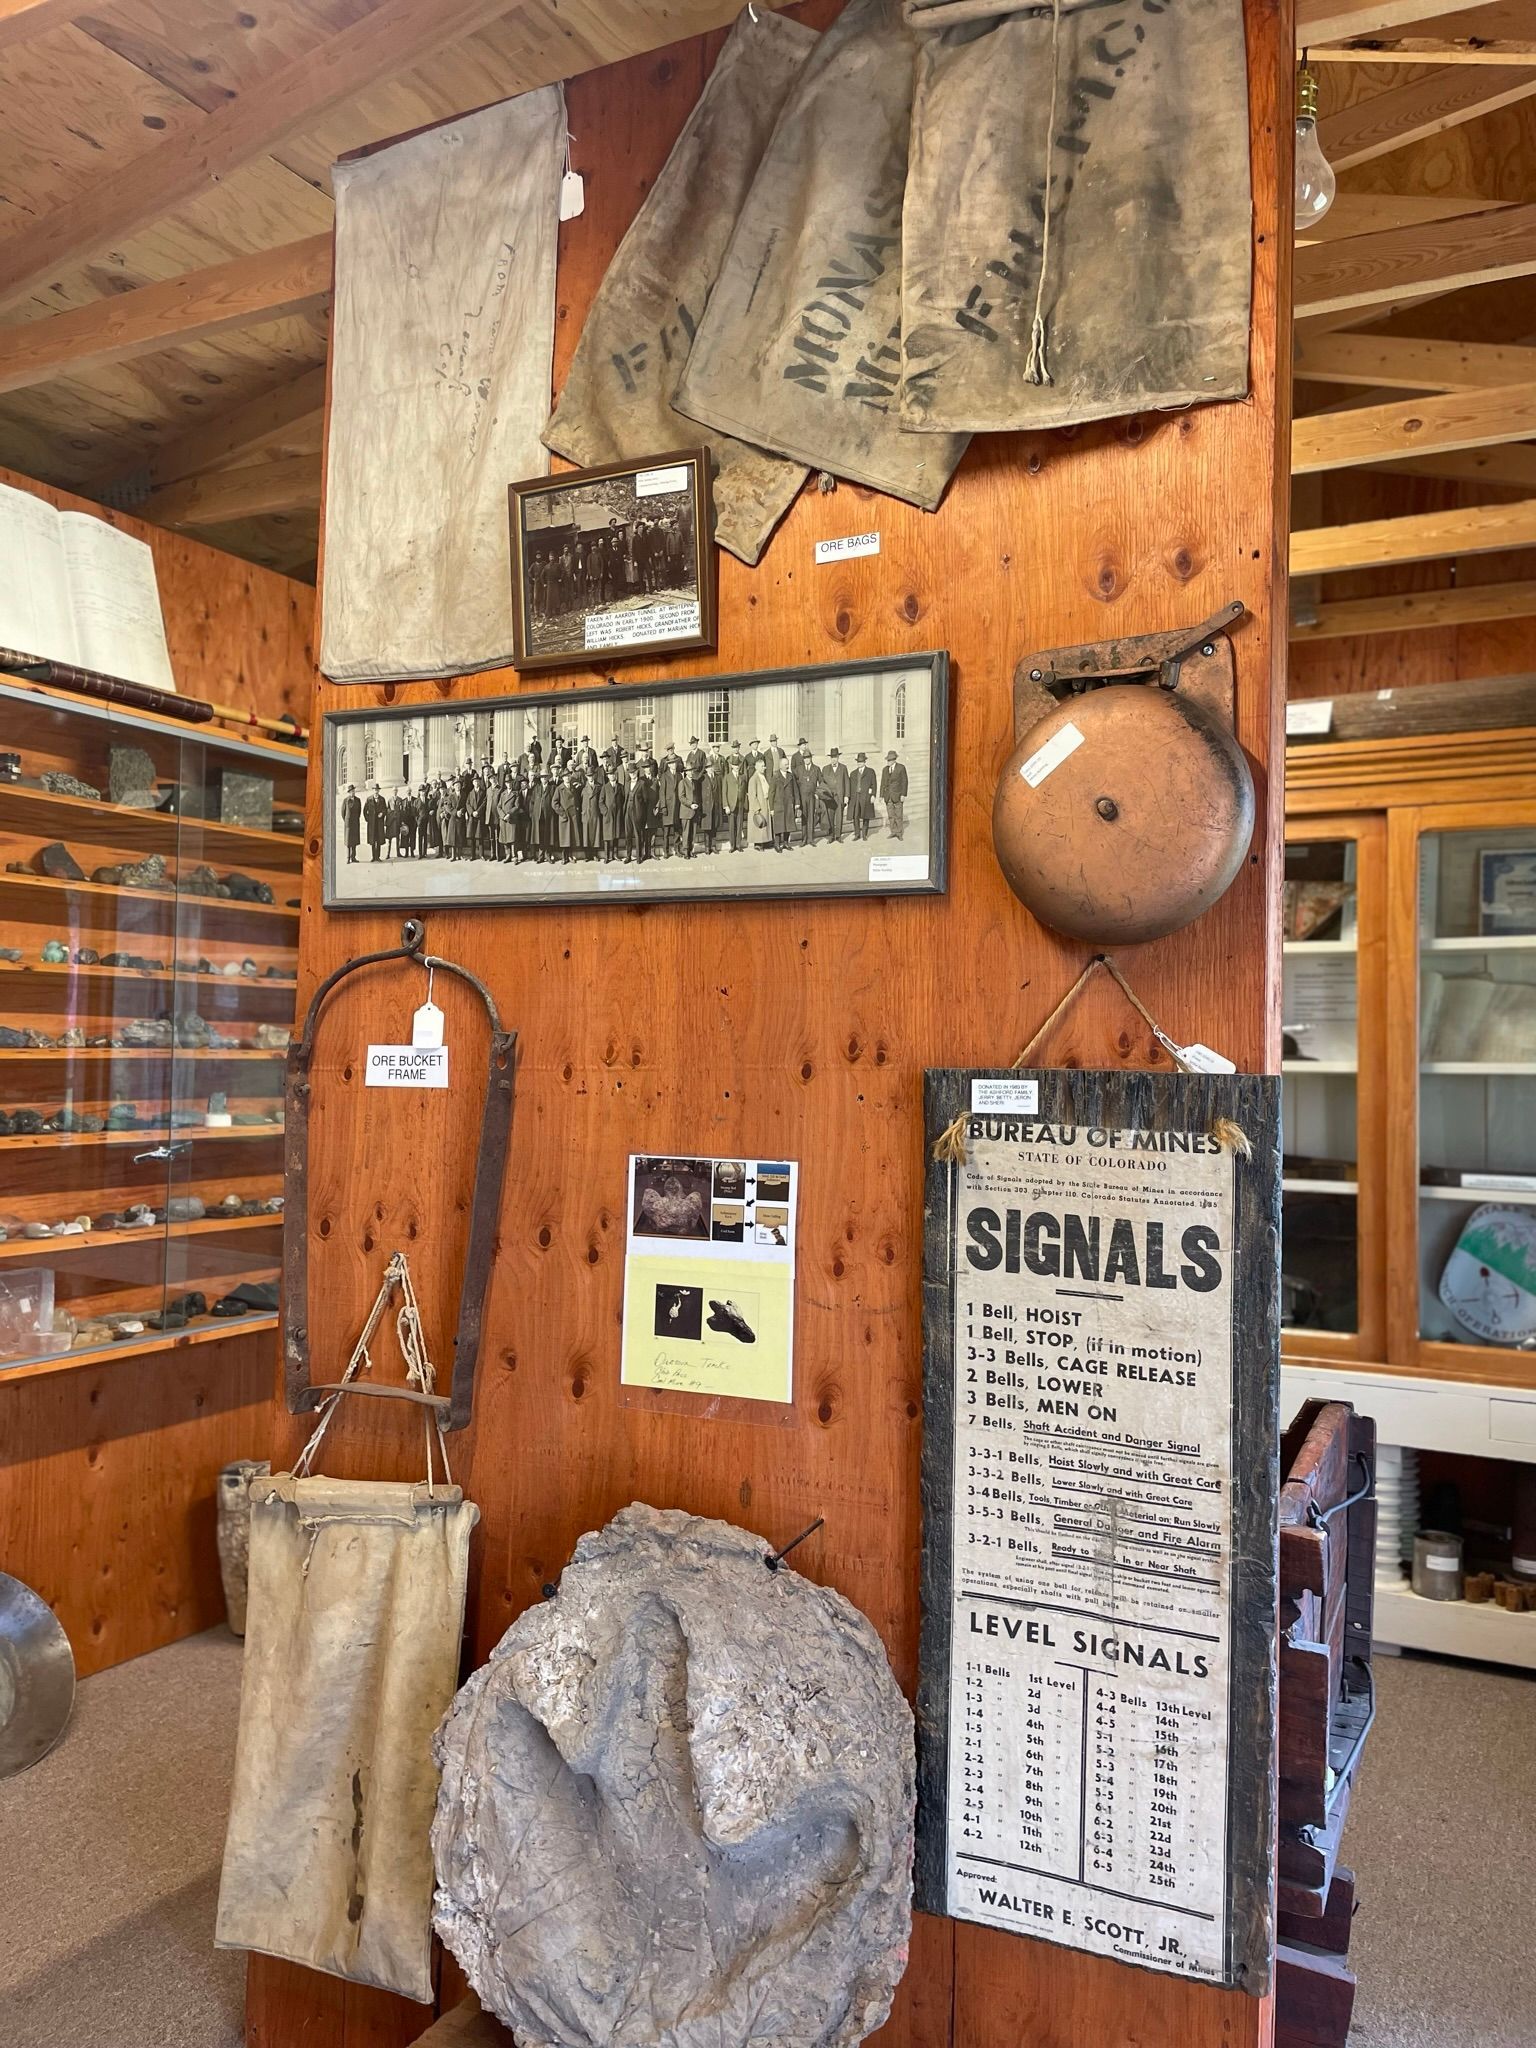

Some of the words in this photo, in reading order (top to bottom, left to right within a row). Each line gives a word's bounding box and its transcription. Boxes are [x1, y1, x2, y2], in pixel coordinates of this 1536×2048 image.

[821, 540, 843, 552] ORE
[848, 534, 876, 548] BAGS
[587, 622, 613, 630] COLORADO
[655, 617, 691, 627] GRANDFATHER
[372, 1056, 395, 1066] ORE
[399, 1055, 443, 1066] BUCKET
[388, 1069, 426, 1079] FRAME
[969, 1120, 1076, 1146] BUREAU
[1086, 1126, 1122, 1149] OF
[1132, 1129, 1221, 1154] MINES
[1018, 1152, 1059, 1164] STATE
[1066, 1155, 1082, 1165] OF
[1089, 1156, 1167, 1172] COLORADO
[1025, 1178, 1053, 1186] adopted
[1103, 1183, 1128, 1191] Bureau
[1180, 1188, 1223, 1197] accordance
[966, 1207, 1222, 1293] SIGNALS
[967, 1303, 973, 1315] 1
[983, 1304, 1017, 1321] Bell,
[1026, 1308, 1082, 1326] HOIST
[967, 1325, 972, 1337] 1
[983, 1326, 1017, 1344] Bell,
[1026, 1330, 1077, 1351] STOP,
[1087, 1336, 1103, 1354] (if
[1109, 1340, 1124, 1355] in
[1132, 1347, 1201, 1367] motion)
[968, 1346, 995, 1362] 3-3
[1006, 1350, 1048, 1370] Bells,
[1057, 1356, 1108, 1375] CAGE
[1117, 1363, 1196, 1386] RELEASE
[967, 1368, 977, 1382] 2
[986, 1370, 1028, 1390] Bells,
[1038, 1376, 1103, 1397] LOWER
[968, 1391, 976, 1404] 3
[986, 1392, 1028, 1412] Bells,
[1037, 1399, 1078, 1417] MEN
[1088, 1405, 1116, 1422] ON
[969, 1415, 976, 1424] 7
[983, 1416, 1016, 1431] Bells,
[1024, 1420, 1050, 1432] Shaft
[1055, 1424, 1097, 1438] Accident
[1102, 1433, 1120, 1443] and
[1125, 1434, 1163, 1450] Danger
[1168, 1440, 1200, 1453] Signal
[969, 1447, 1002, 1460] 3-3-1
[1009, 1452, 1043, 1467] Bells,
[1049, 1455, 1074, 1467] Hoist
[1078, 1459, 1109, 1473] Slowly
[1113, 1466, 1132, 1476] and
[1136, 1469, 1159, 1480] with
[1163, 1473, 1192, 1485] Great
[1197, 1478, 1221, 1489] Care
[969, 1466, 1004, 1480] 3-3-2
[1012, 1471, 1045, 1487] Bells,
[1053, 1477, 1075, 1487] Lower
[1078, 1481, 1104, 1493] Slowly
[1107, 1485, 1122, 1495] and
[1125, 1489, 1143, 1499] with
[1146, 1493, 1170, 1502] Great
[1173, 1497, 1193, 1506] Care
[968, 1486, 990, 1498] 3-4
[992, 1489, 1025, 1504] Bells,
[1029, 1493, 1051, 1504] Tools,
[1054, 1497, 1081, 1508] Timber
[1174, 1517, 1191, 1527] Run
[1193, 1521, 1221, 1532] Slowly
[968, 1505, 1003, 1519] 3-5-3
[1011, 1510, 1044, 1526] Bells,
[1054, 1514, 1092, 1527] General
[1097, 1519, 1133, 1535] Dager
[1138, 1530, 1159, 1540] and
[1163, 1532, 1181, 1543] Fire
[1187, 1537, 1220, 1550] Alarm
[969, 1533, 1001, 1547] 3-2-1
[1008, 1539, 1042, 1554] Bells,
[1052, 1543, 1076, 1554] Ready
[1123, 1556, 1131, 1564] In
[1148, 1560, 1169, 1571] Near
[1174, 1564, 1196, 1575] Shaft
[978, 1570, 1000, 1579] system
[1016, 1576, 1033, 1585] using
[1003, 1584, 1037, 1594] especially
[970, 1611, 1056, 1647] LEVEL
[1073, 1630, 1209, 1679] SIGNALS
[967, 1662, 980, 1672] 1-1
[985, 1665, 1010, 1677] Bells
[1029, 1674, 1042, 1684] 1st
[1047, 1677, 1075, 1690] Level
[1096, 1688, 1115, 1700] 4-3
[1121, 1694, 1147, 1708] Bells
[1156, 1702, 1180, 1714] 13th
[1183, 1706, 1211, 1720] Level
[967, 1708, 983, 1718] 1-4
[1026, 1719, 1044, 1730] 4th
[1096, 1717, 1115, 1728] 4-5
[1155, 1730, 1178, 1743] 15th
[966, 1723, 982, 1733] 1-5
[1027, 1734, 1043, 1746] 5th
[965, 1753, 983, 1764] 2-2
[1026, 1765, 1043, 1777] 7th
[1096, 1760, 1114, 1772] 5-3
[1154, 1774, 1177, 1786] 18th
[963, 1813, 980, 1824] 4-1
[1020, 1810, 1042, 1822] 10th
[964, 1828, 983, 1839] 4-2
[1020, 1840, 1041, 1853] 12th
[1094, 1845, 1113, 1858] 6-4
[1150, 1845, 1171, 1858] 23d
[956, 1868, 997, 1883] Approved:
[1093, 1860, 1112, 1872] 6-5
[1149, 1874, 1175, 1888] 25th
[978, 1888, 1054, 1920] WALTER
[1063, 1909, 1075, 1926] E.
[1085, 1916, 1149, 1948] SCOTT,
[1159, 1936, 1187, 1958] JR.,
[1113, 1944, 1172, 1965] Commissioner
[1176, 1961, 1184, 1969] of
